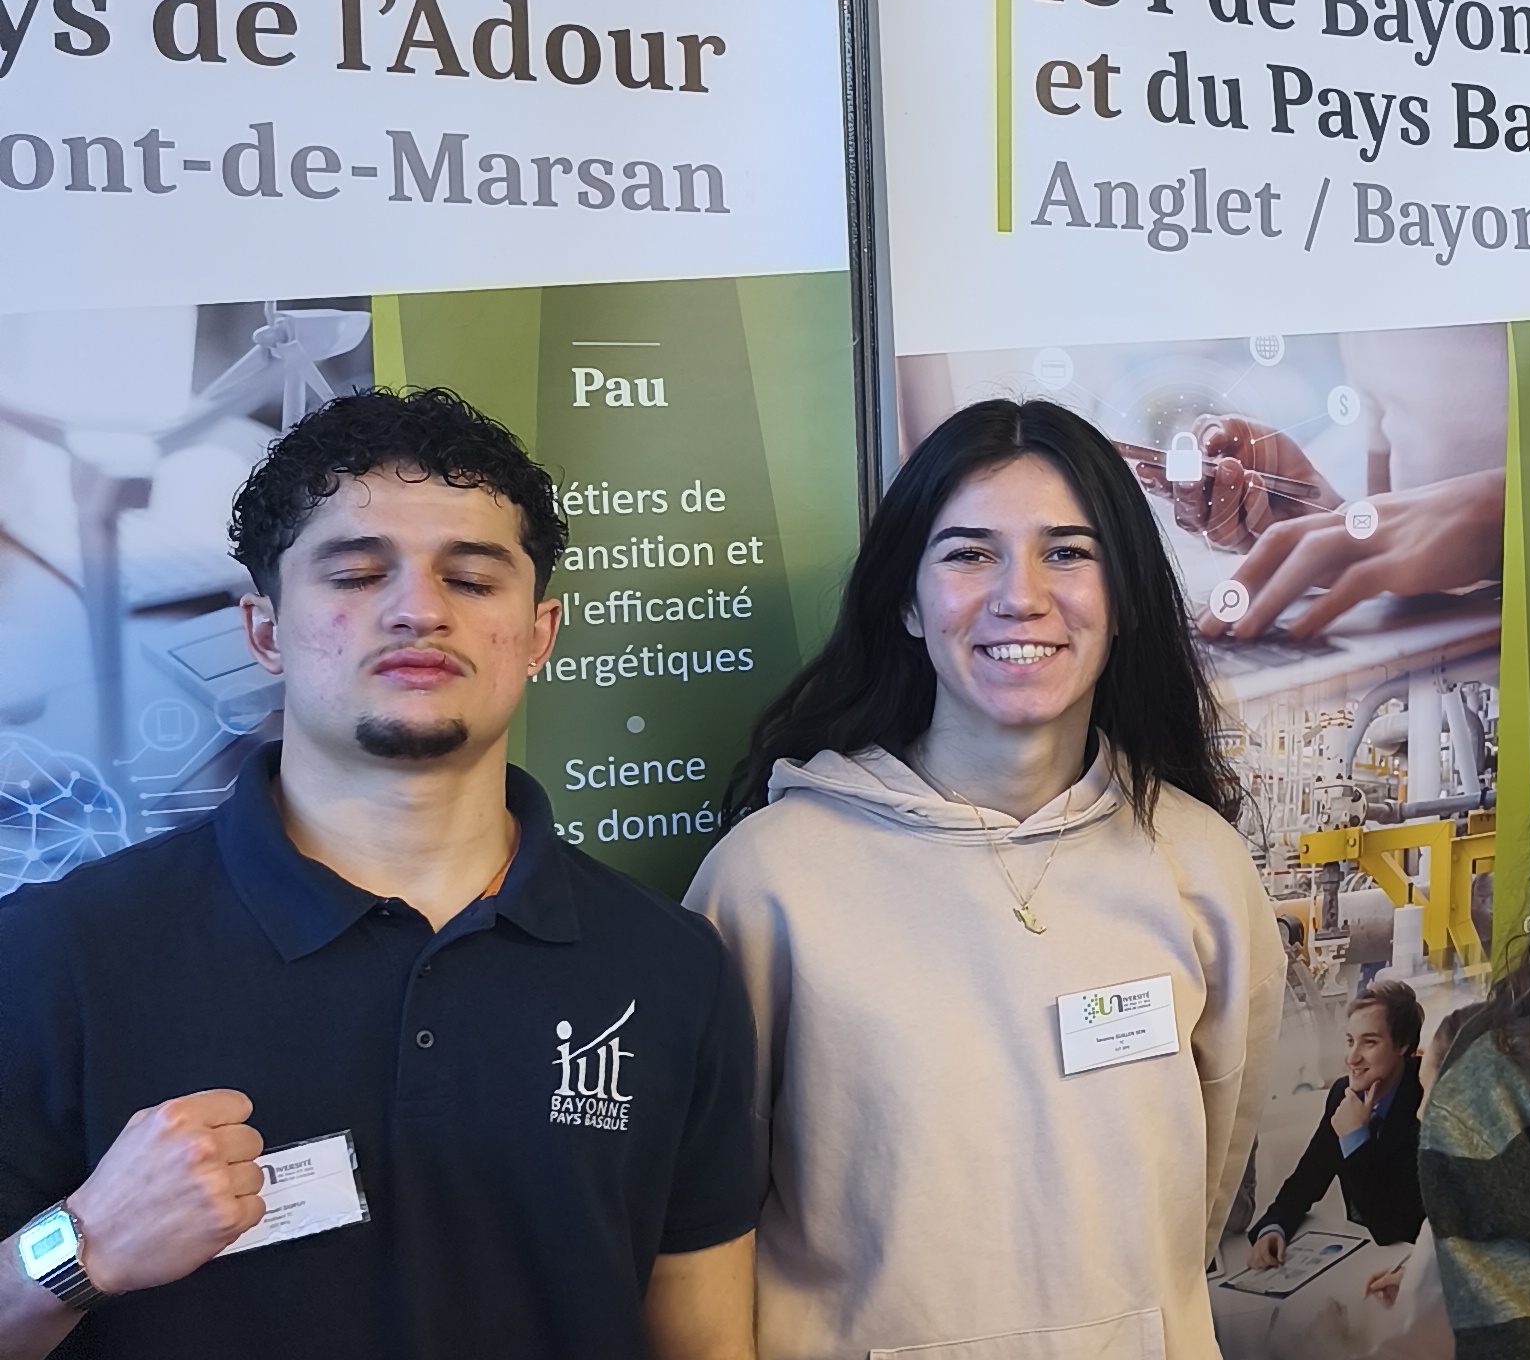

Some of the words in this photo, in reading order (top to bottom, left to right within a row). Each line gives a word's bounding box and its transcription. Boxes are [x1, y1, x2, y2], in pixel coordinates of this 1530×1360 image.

[1034, 51, 1122, 119] et
[1147, 50, 1248, 130] du
[1266, 63, 1430, 163] Pays
[1031, 160, 1283, 252] Anglet
[571, 367, 669, 408] Pau
[681, 480, 726, 513] de
[727, 536, 763, 566] et
[562, 585, 753, 626] l'efficacité
[565, 756, 706, 791] Science
[549, 1111, 582, 1127] PAYS
[584, 1114, 629, 1131] BASQUE
[550, 1095, 630, 1120] BAYONNE
